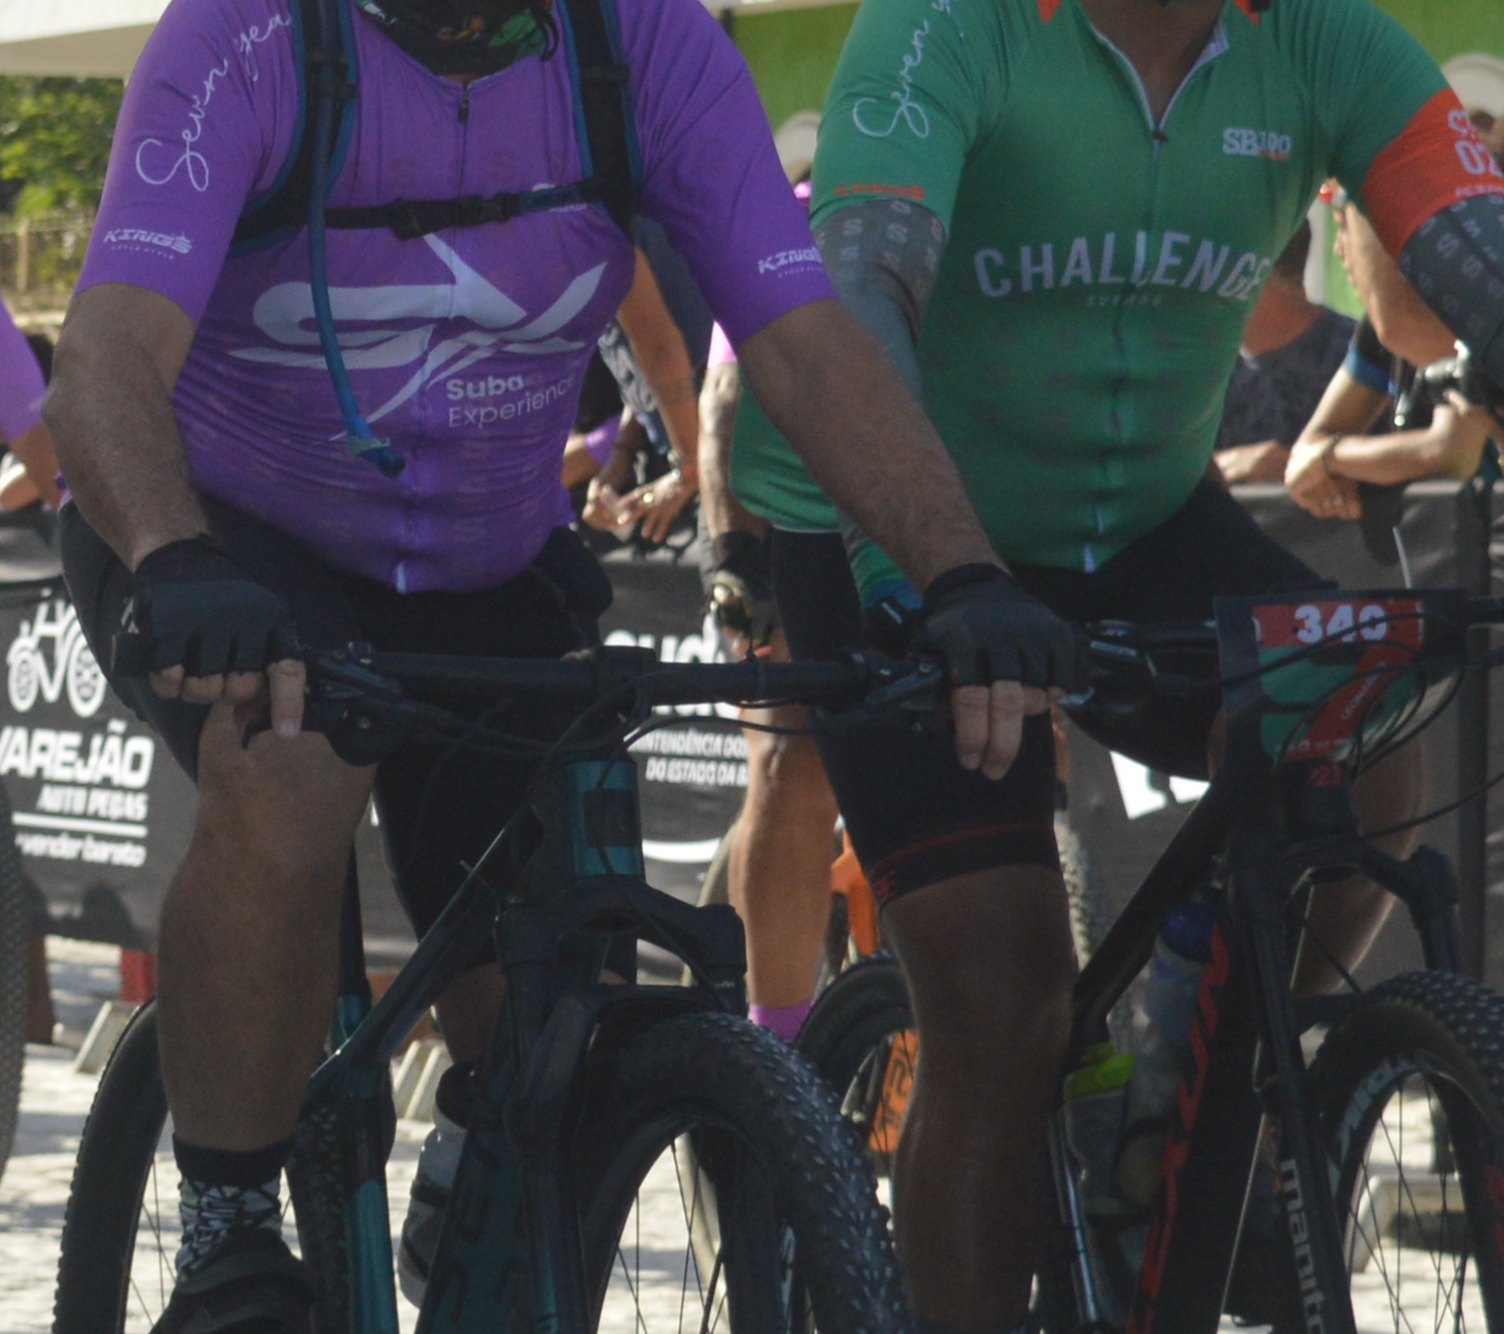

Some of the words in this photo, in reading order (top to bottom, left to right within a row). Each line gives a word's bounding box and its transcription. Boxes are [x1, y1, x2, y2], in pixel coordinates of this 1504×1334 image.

[104, 228, 193, 255] KINGS
[445, 372, 525, 402] Suba
[1294, 604, 1388, 644] 340
